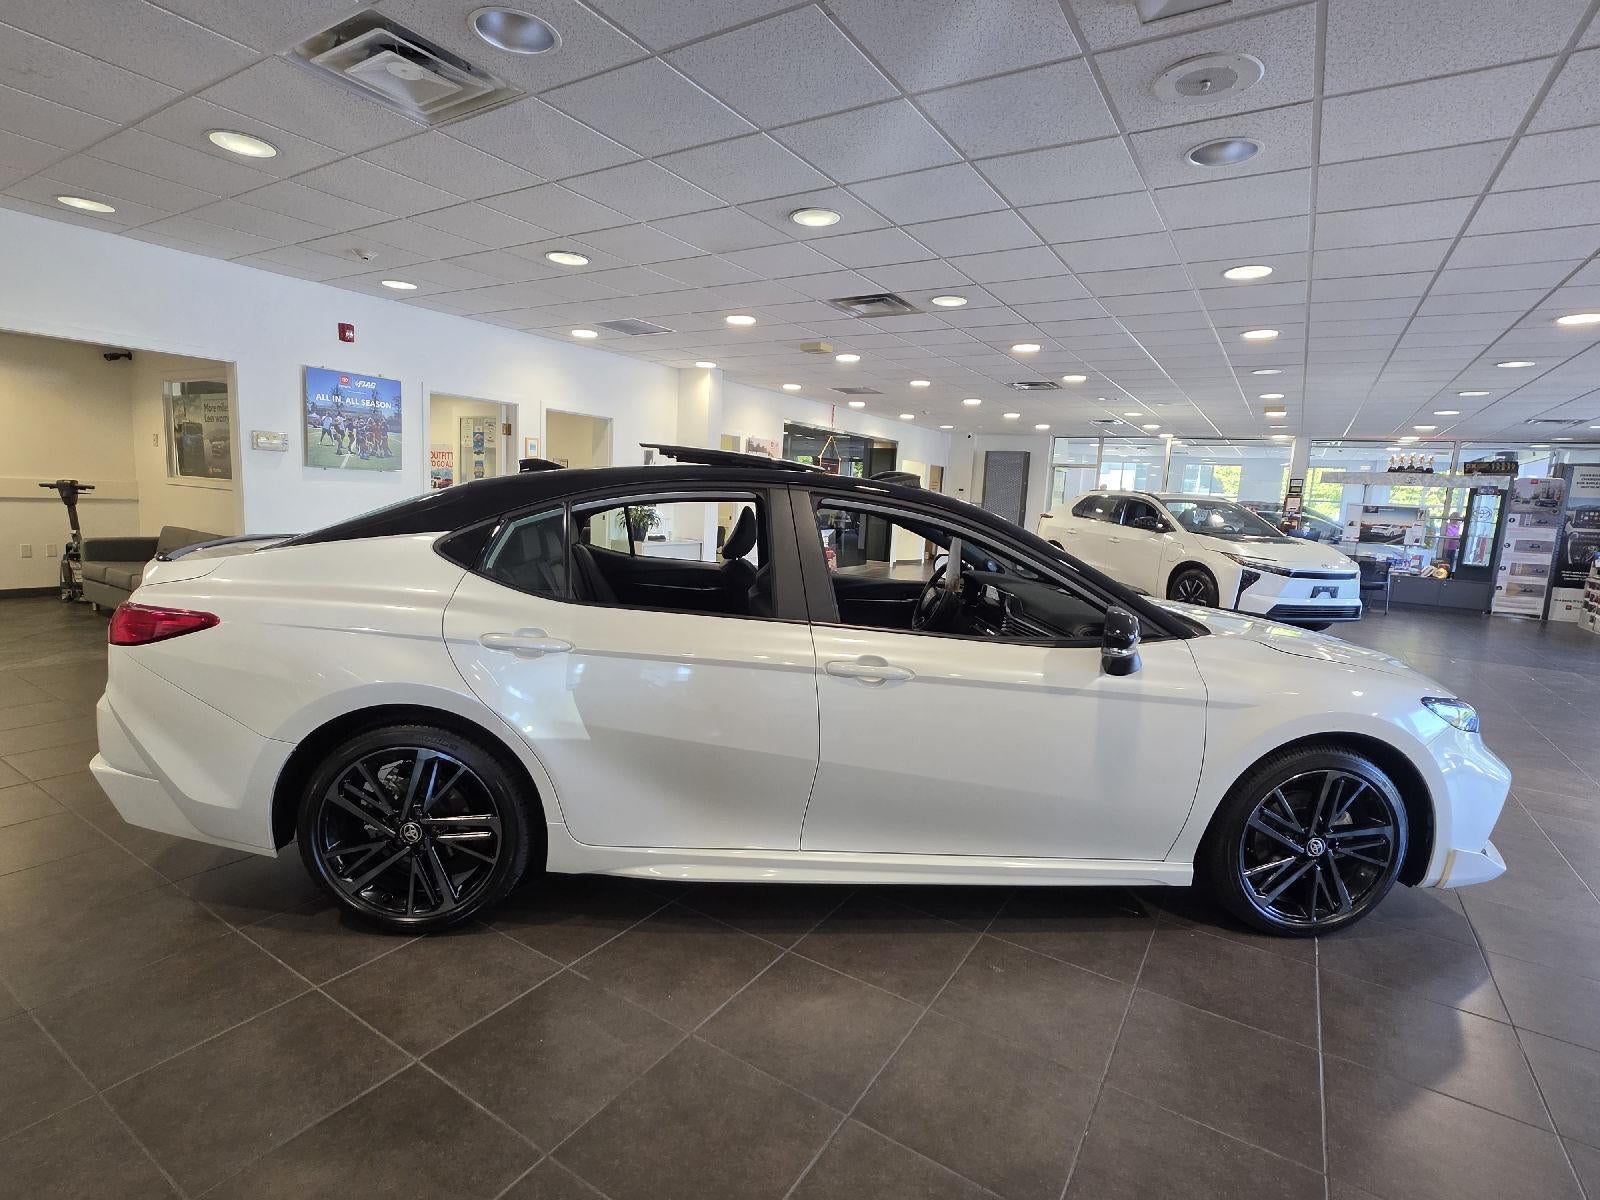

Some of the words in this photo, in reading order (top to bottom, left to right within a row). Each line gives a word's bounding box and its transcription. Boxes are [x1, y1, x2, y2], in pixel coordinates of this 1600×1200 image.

[315, 393, 331, 402] ALL
[345, 397, 360, 405] ALL
[361, 399, 392, 409] SEASON
